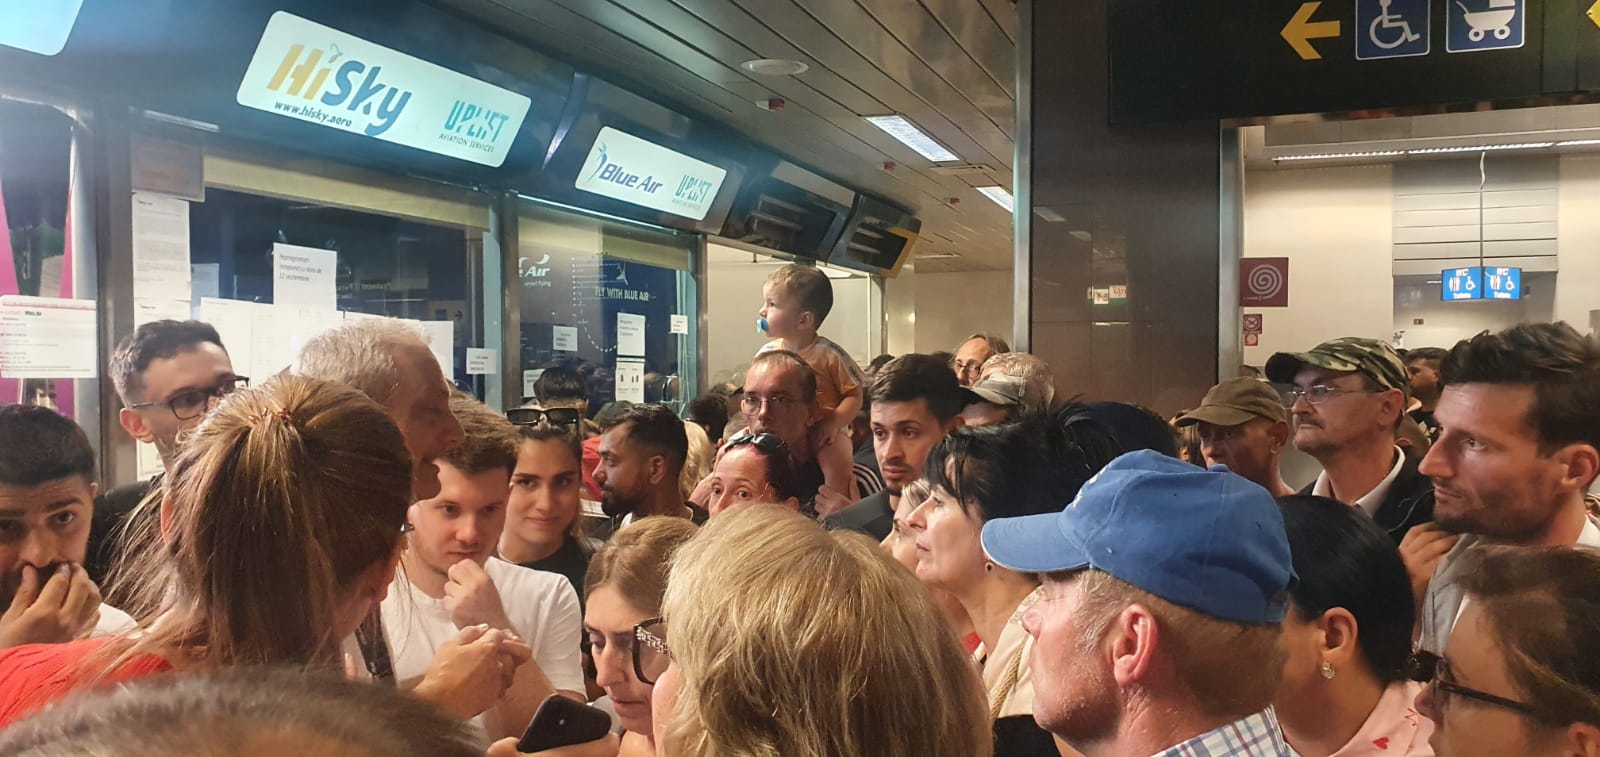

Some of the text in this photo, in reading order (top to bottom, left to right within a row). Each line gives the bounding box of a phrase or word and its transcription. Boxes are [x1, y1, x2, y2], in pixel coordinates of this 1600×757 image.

[267, 44, 412, 136] HiSky
[274, 101, 352, 127] www.hisky.aero
[444, 99, 509, 144] UPLIFT
[438, 133, 494, 153] AVIATION SERVICES
[598, 163, 663, 194] Blue Air
[675, 174, 712, 203] UPLIFT
[525, 265, 550, 277] Air
[1456, 268, 1469, 276] WC
[1497, 268, 1509, 276] WC
[595, 288, 649, 301] FLY WITH BLUE AIR
